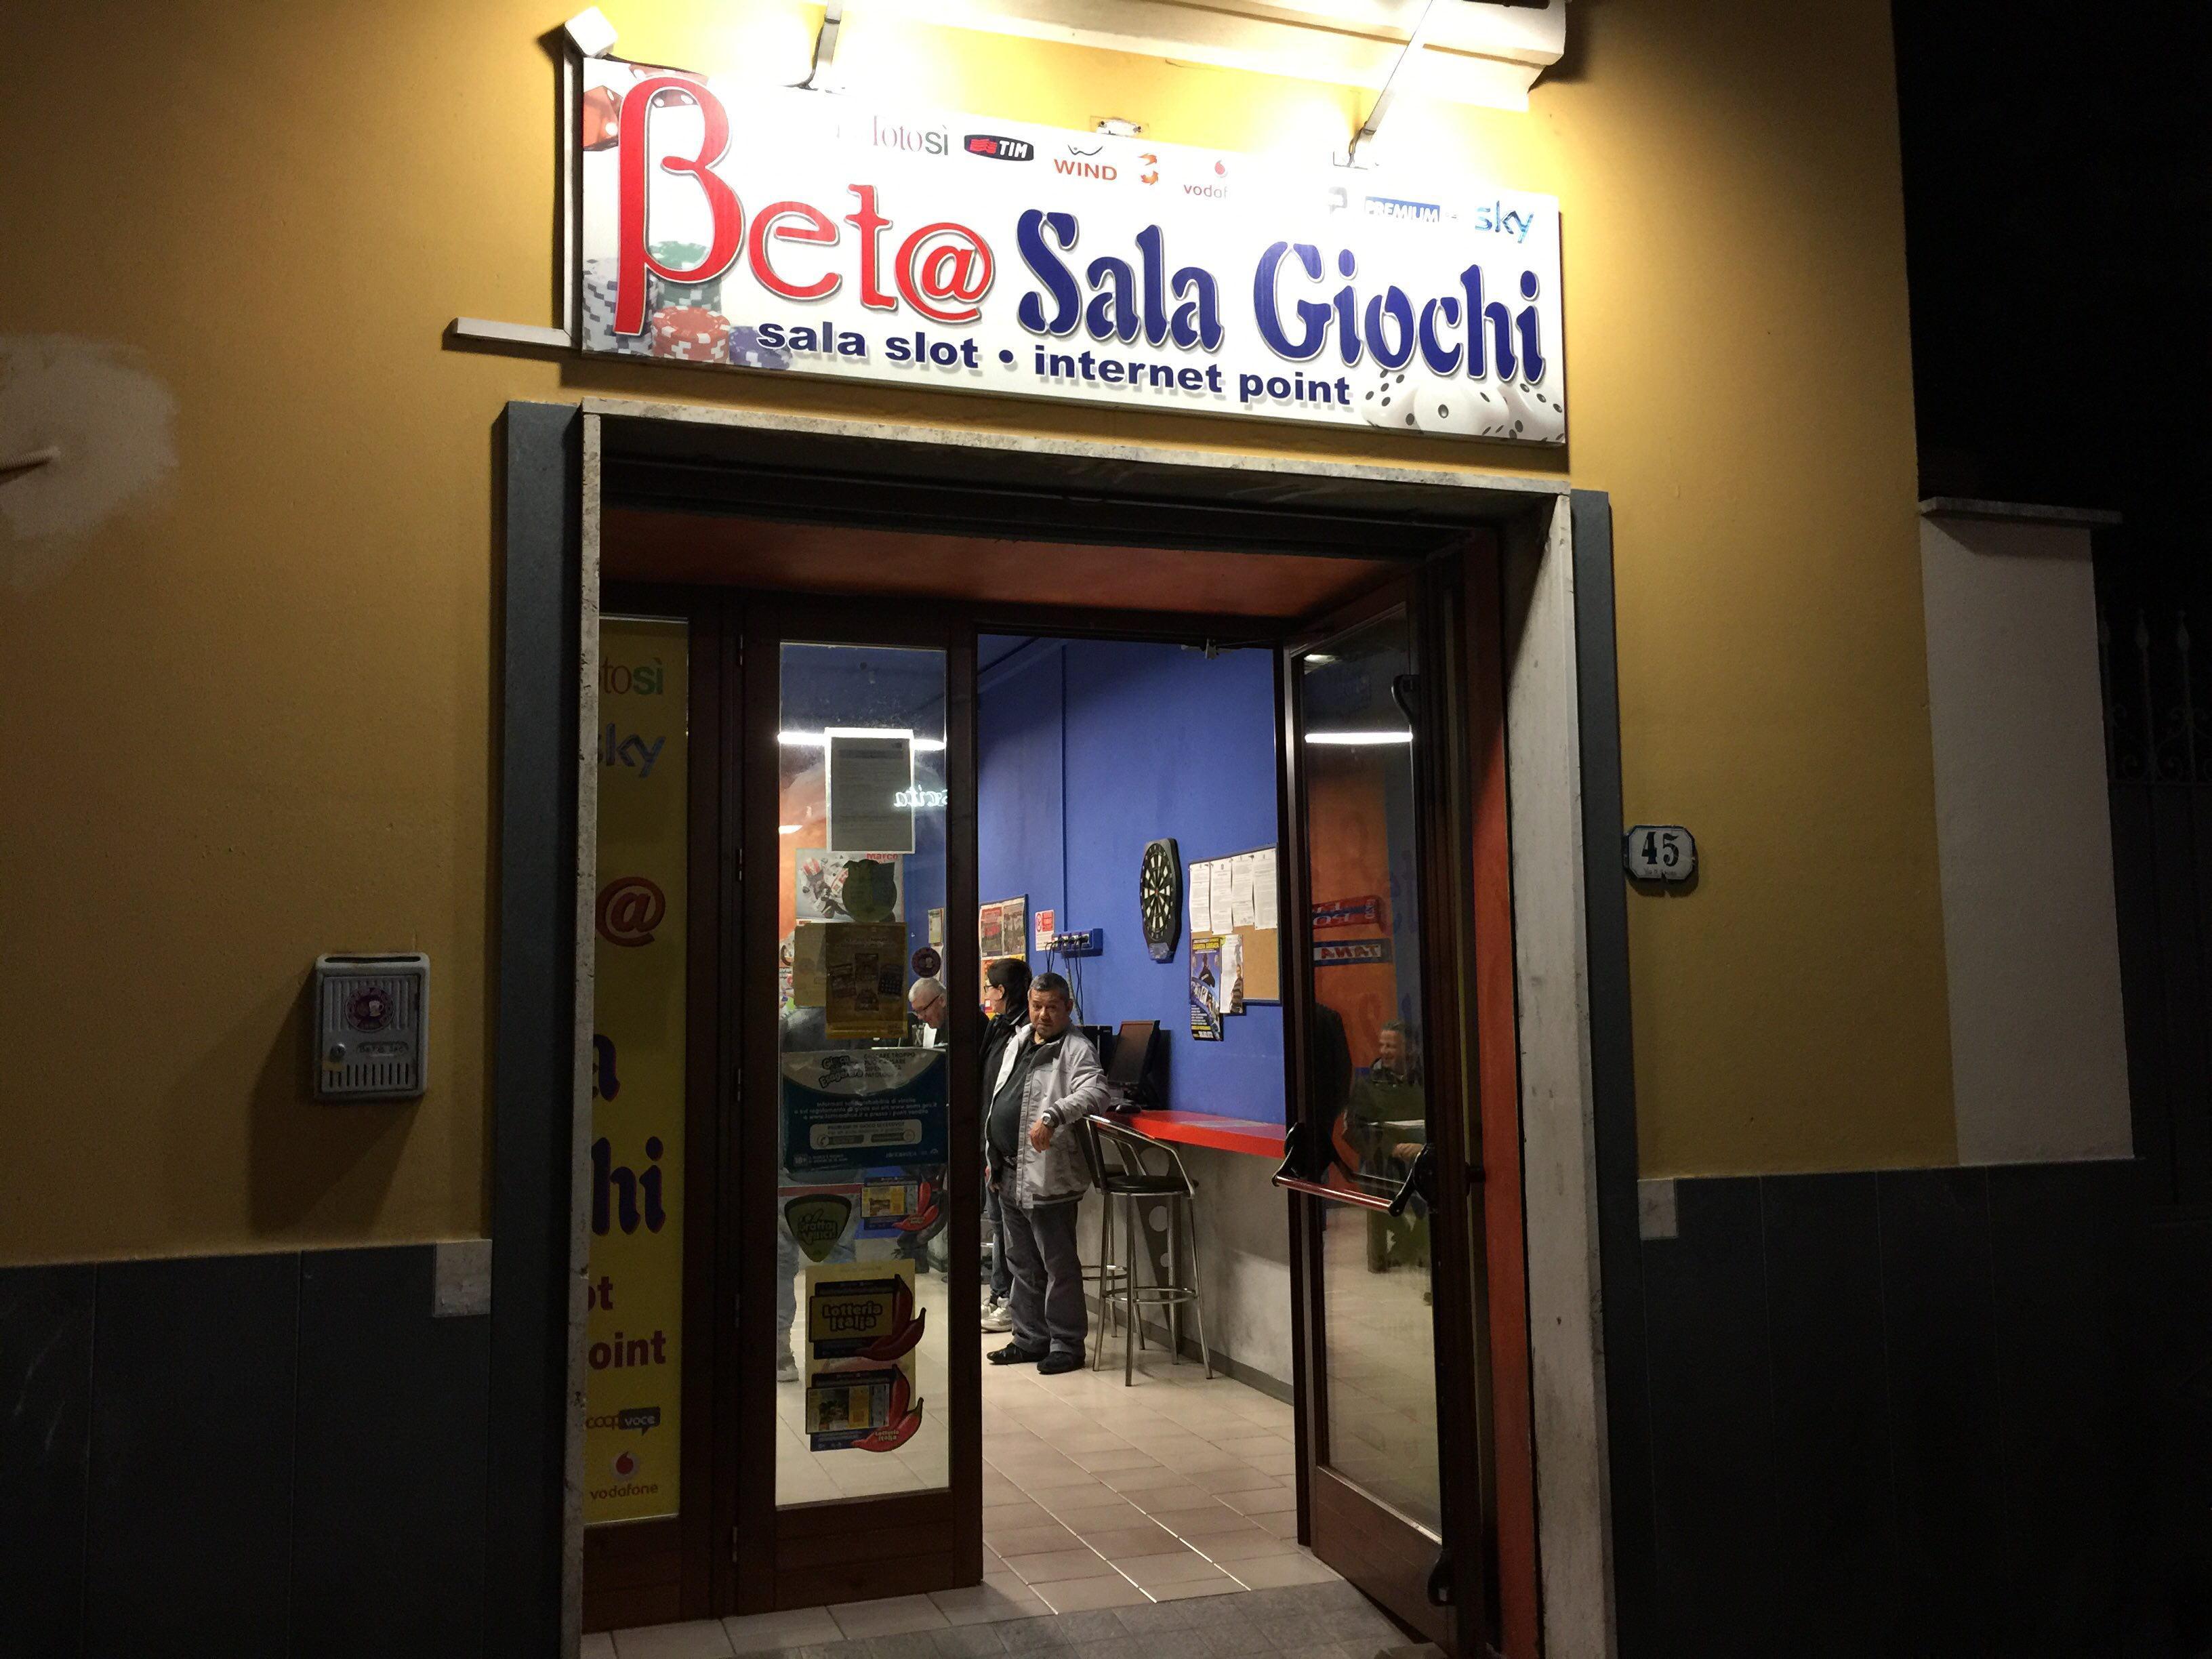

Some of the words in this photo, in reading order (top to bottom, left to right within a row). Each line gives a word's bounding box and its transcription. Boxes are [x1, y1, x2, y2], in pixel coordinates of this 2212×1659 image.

[998, 140, 1029, 159] TIM
[1054, 158, 1118, 182] WIND
[1365, 199, 1439, 222] PREMIUM
[1475, 201, 1534, 243] sky
[1015, 209, 1225, 353] Sala
[1253, 241, 1546, 385] Giochi
[757, 321, 866, 358] sala
[885, 331, 979, 369] slot
[1034, 344, 1222, 394] internet
[1239, 373, 1351, 406] point
[599, 657, 664, 696] tosì
[598, 722, 665, 778] ky
[1641, 832, 1679, 867] 45
[823, 1301, 882, 1317] Lotteria
[831, 1315, 876, 1331] Italia
[590, 1482, 659, 1500] vodafone
